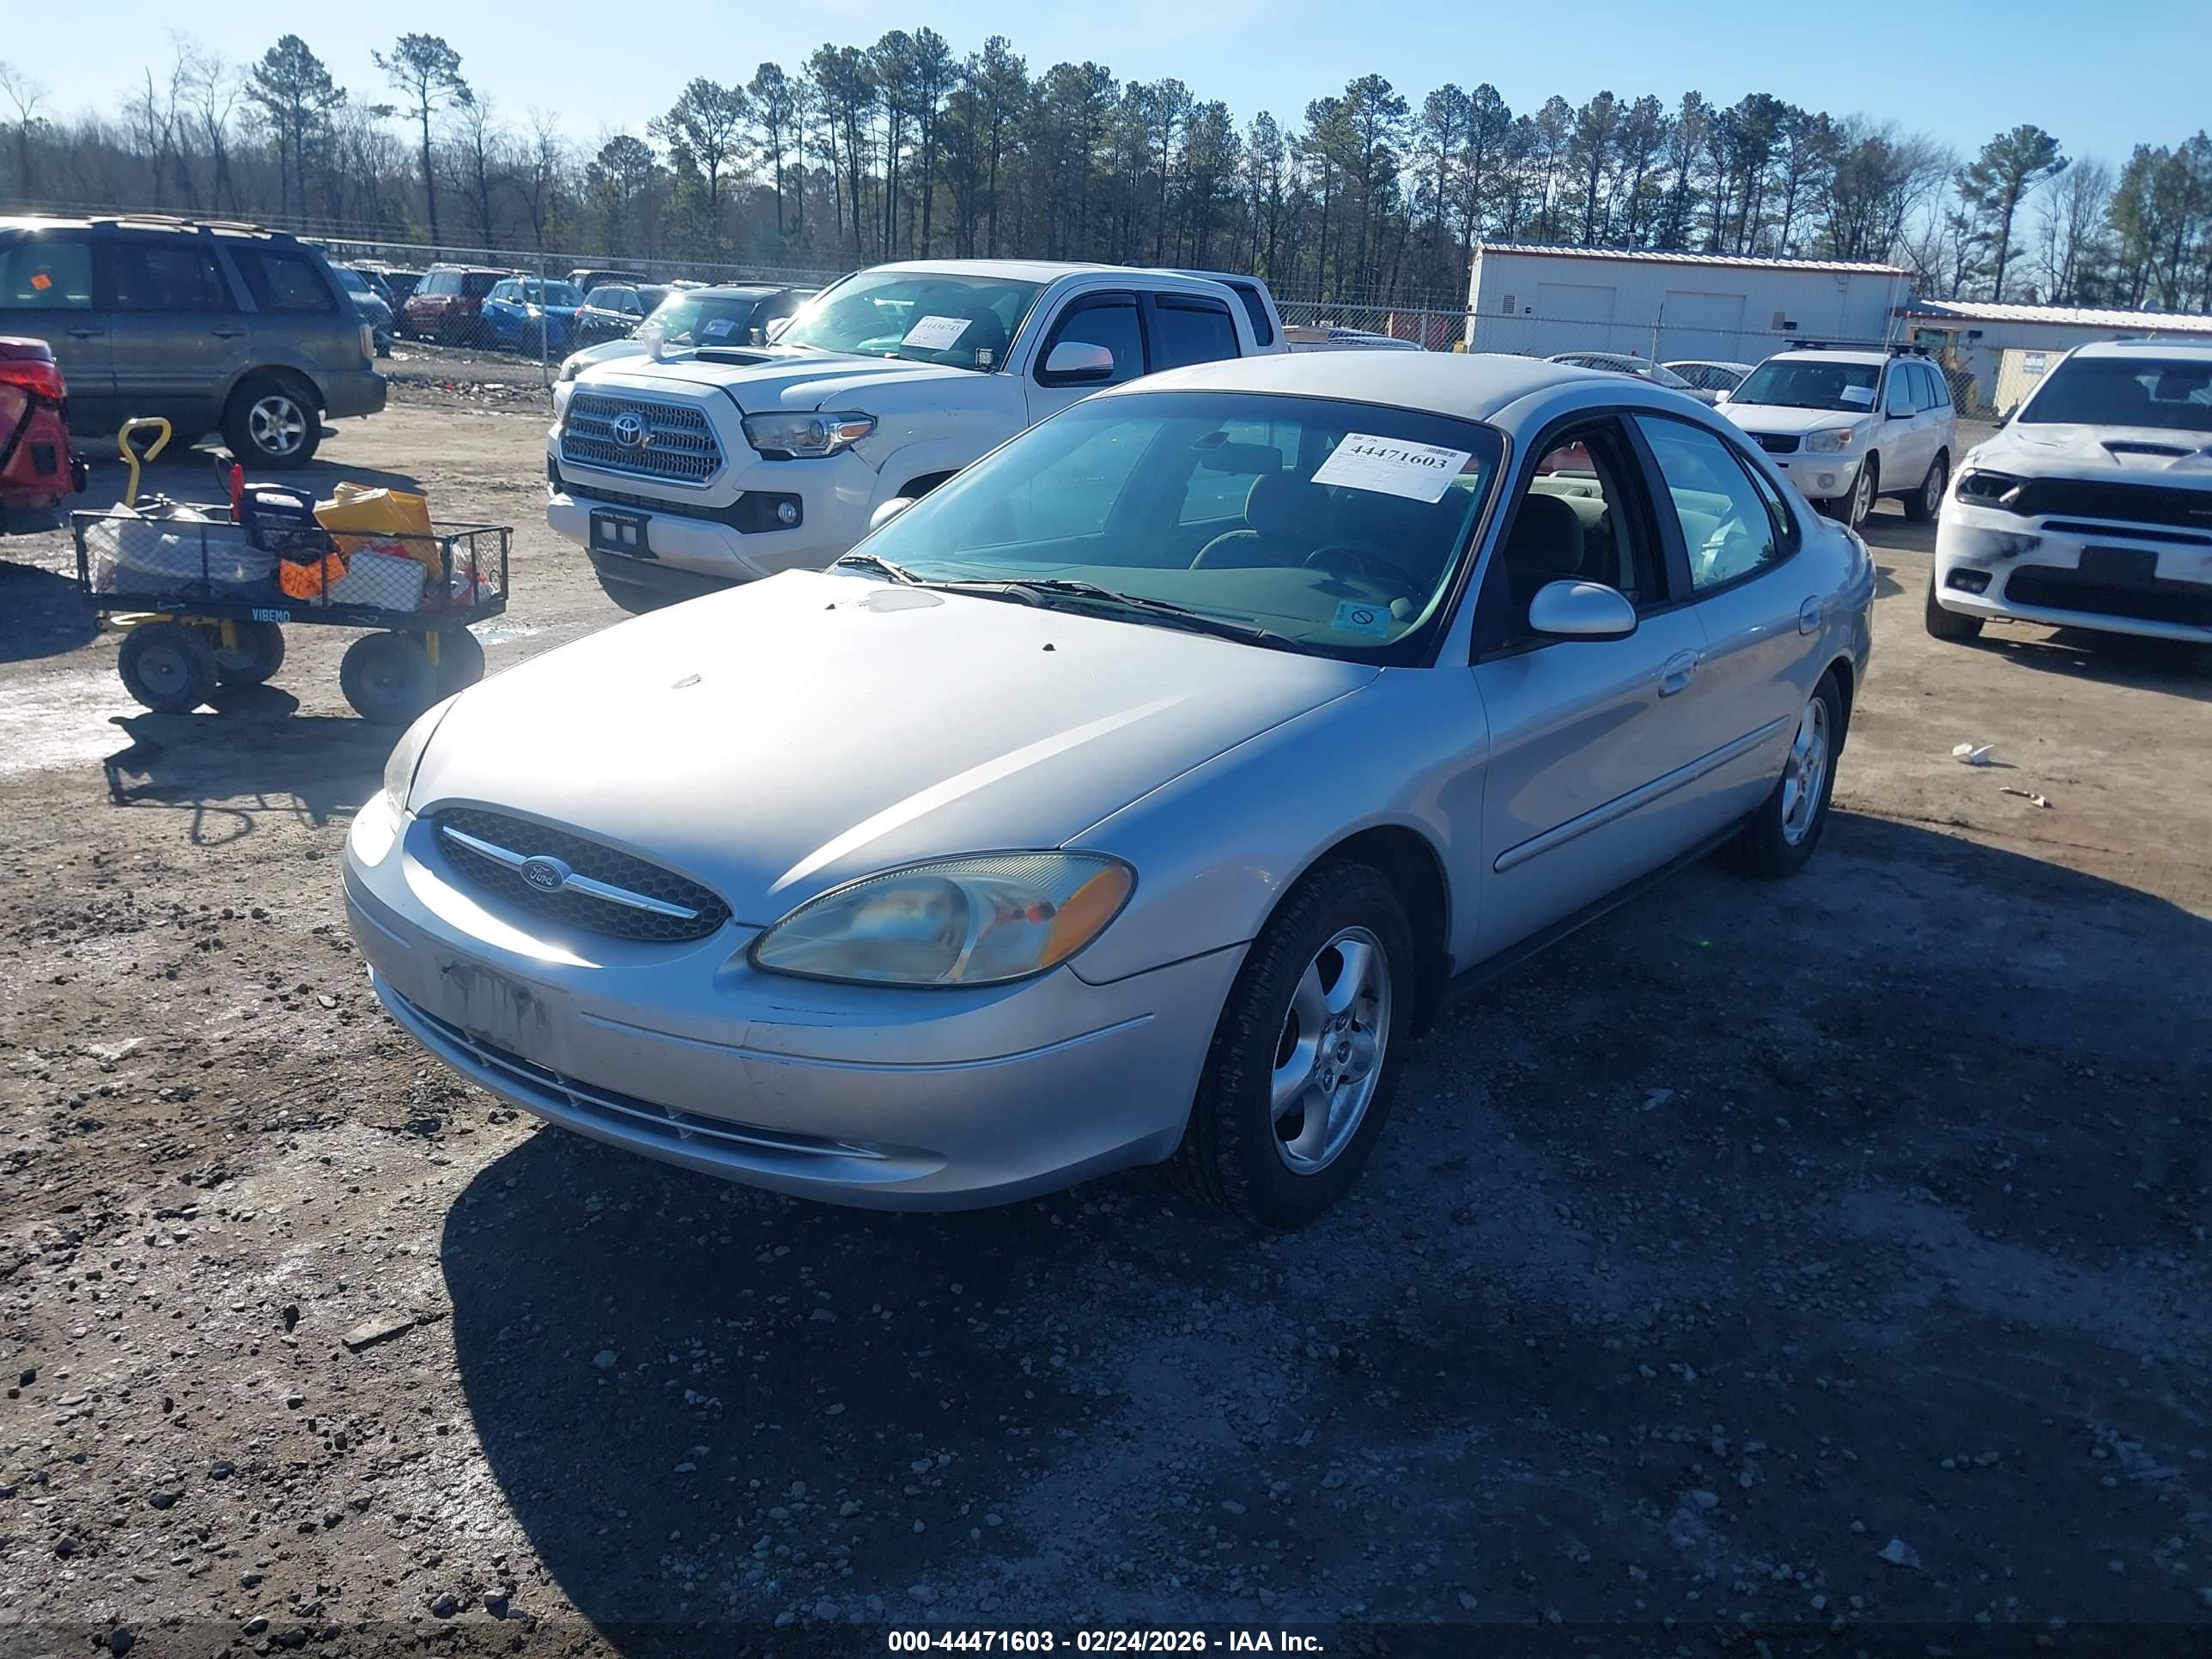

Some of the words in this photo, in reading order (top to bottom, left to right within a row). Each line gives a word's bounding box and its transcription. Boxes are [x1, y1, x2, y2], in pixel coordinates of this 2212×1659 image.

[1350, 444, 1449, 470] 44471603
[252, 608, 290, 623] VIBEMO
[529, 864, 556, 886] Ford
